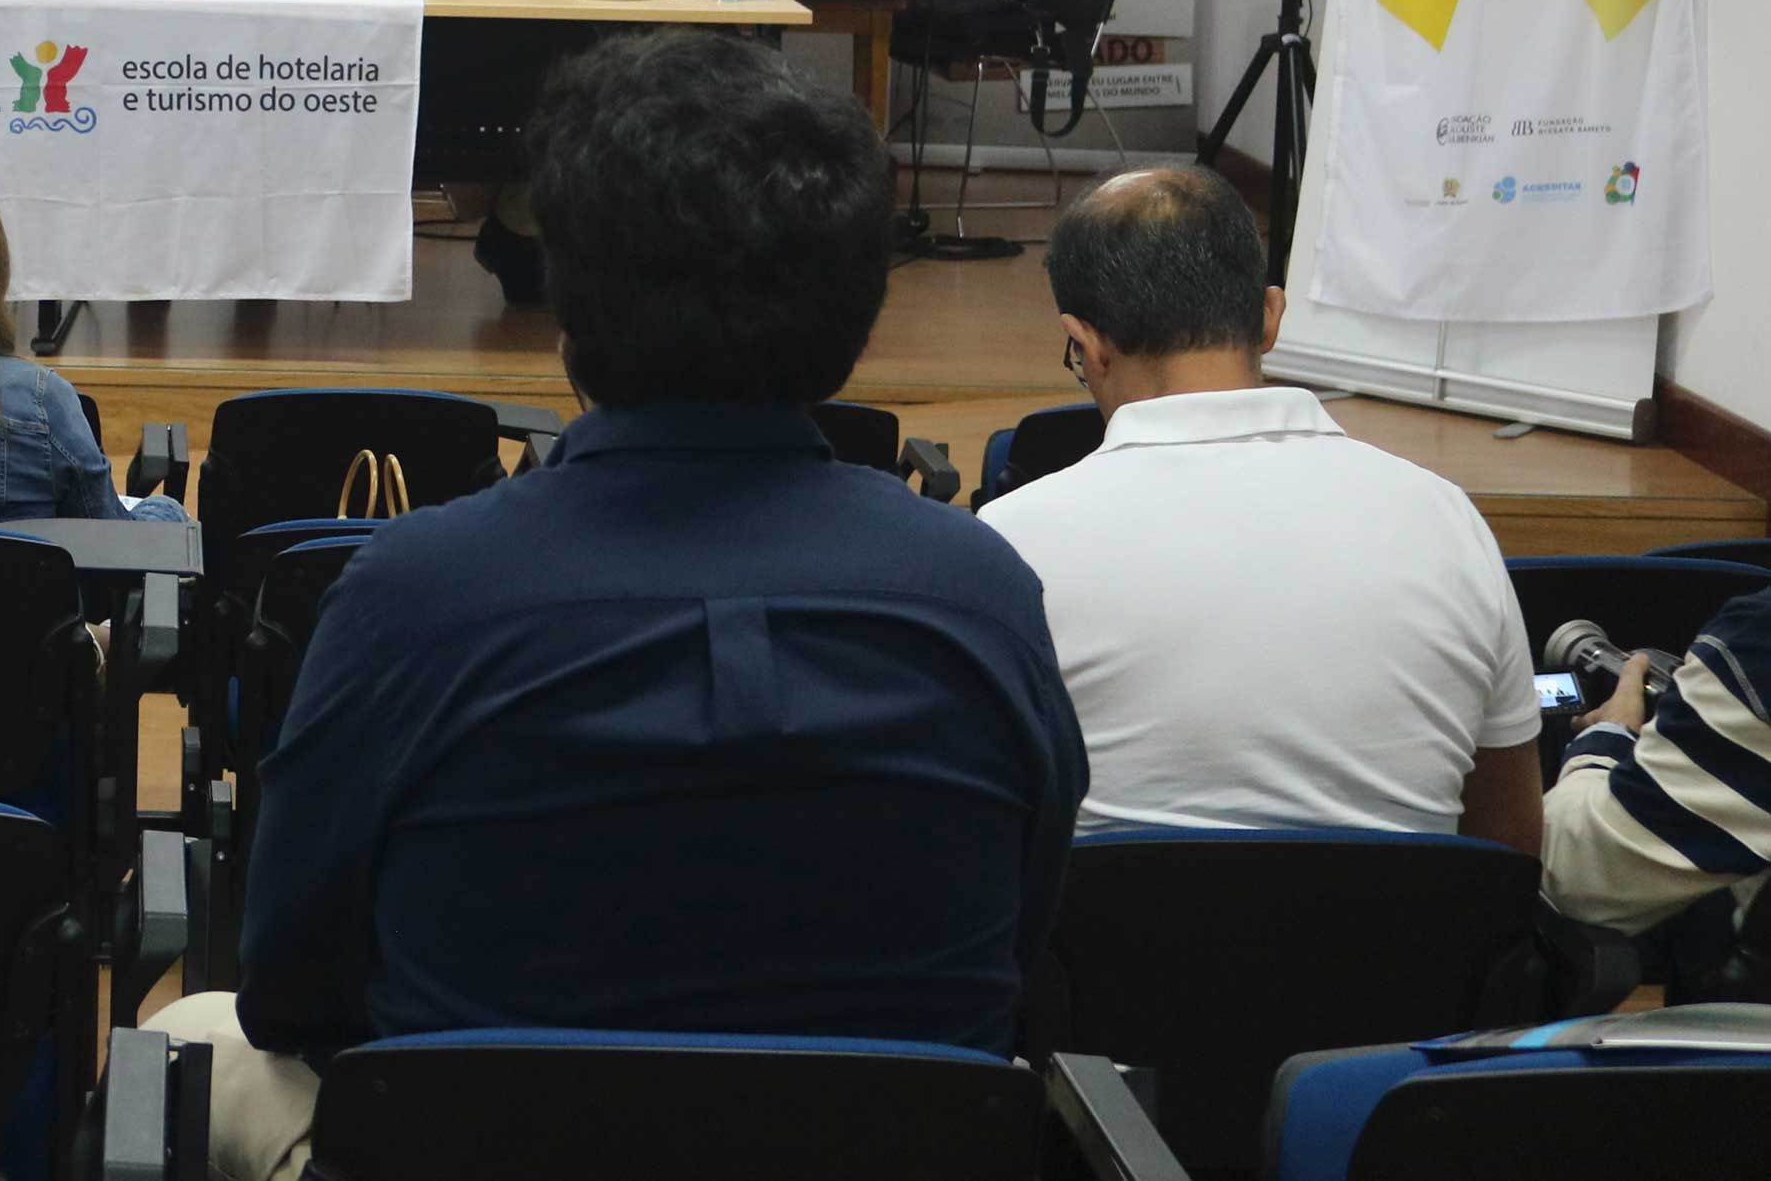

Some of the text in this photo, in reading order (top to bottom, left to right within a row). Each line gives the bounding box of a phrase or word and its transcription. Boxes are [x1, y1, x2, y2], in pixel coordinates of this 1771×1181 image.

[121, 54, 380, 82] escola de hotelaria
[1107, 76, 1140, 86] LUGAR
[1142, 75, 1174, 84] ENTRE
[122, 88, 378, 114] e turismo do oeste
[1102, 88, 1119, 98] DO
[1120, 86, 1160, 98] MUNDO
